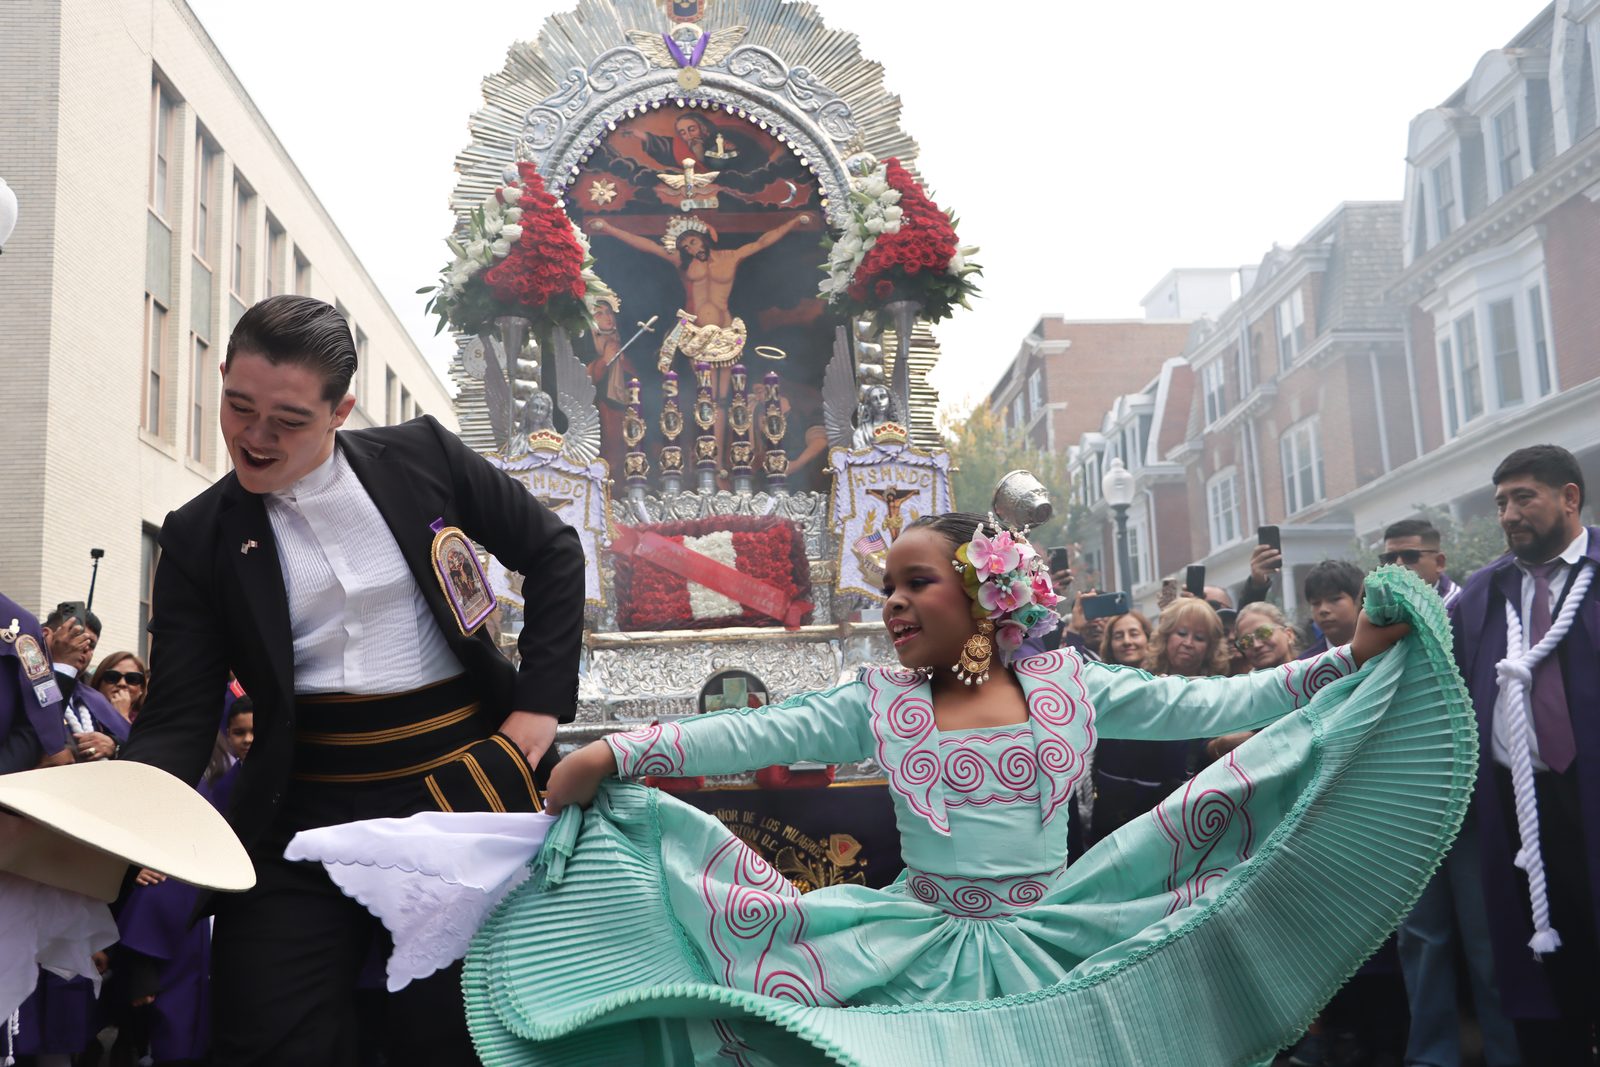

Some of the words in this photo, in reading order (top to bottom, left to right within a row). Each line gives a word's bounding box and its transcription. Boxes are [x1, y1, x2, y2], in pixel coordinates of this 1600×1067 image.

[743, 810, 756, 824] DE
[760, 817, 780, 833] LOS
[782, 824, 825, 859] MILAGROS
